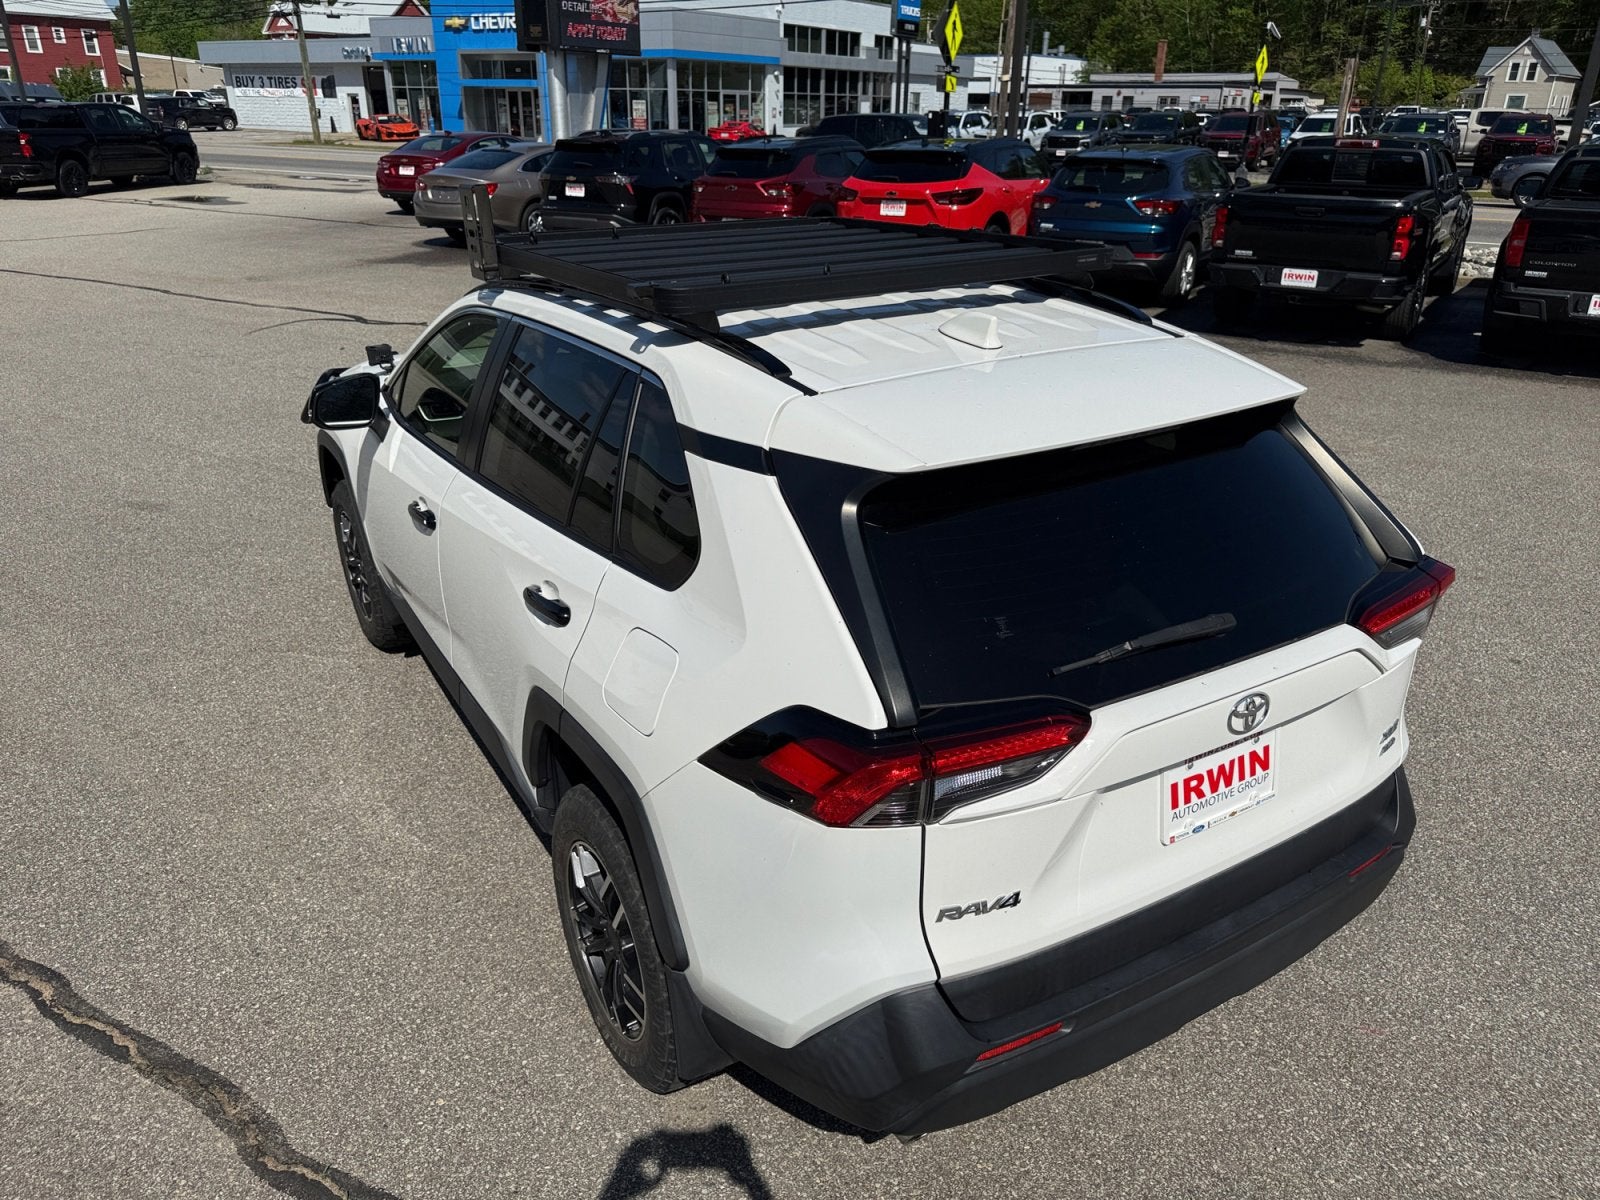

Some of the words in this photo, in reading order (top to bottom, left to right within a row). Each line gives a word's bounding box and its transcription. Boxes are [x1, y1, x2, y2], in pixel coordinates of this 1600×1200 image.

[566, 22, 596, 38] APPLY
[391, 37, 433, 53] IRWIN
[235, 75, 255, 88] BUY
[259, 76, 265, 89] 3
[267, 76, 298, 89] TIRES
[1283, 272, 1315, 282] IRWIN
[1170, 744, 1270, 811] IRWIN
[1171, 786, 1236, 822] AUTOMOTIVE
[1237, 772, 1270, 794] GROUP
[935, 890, 1022, 923] RAV4
